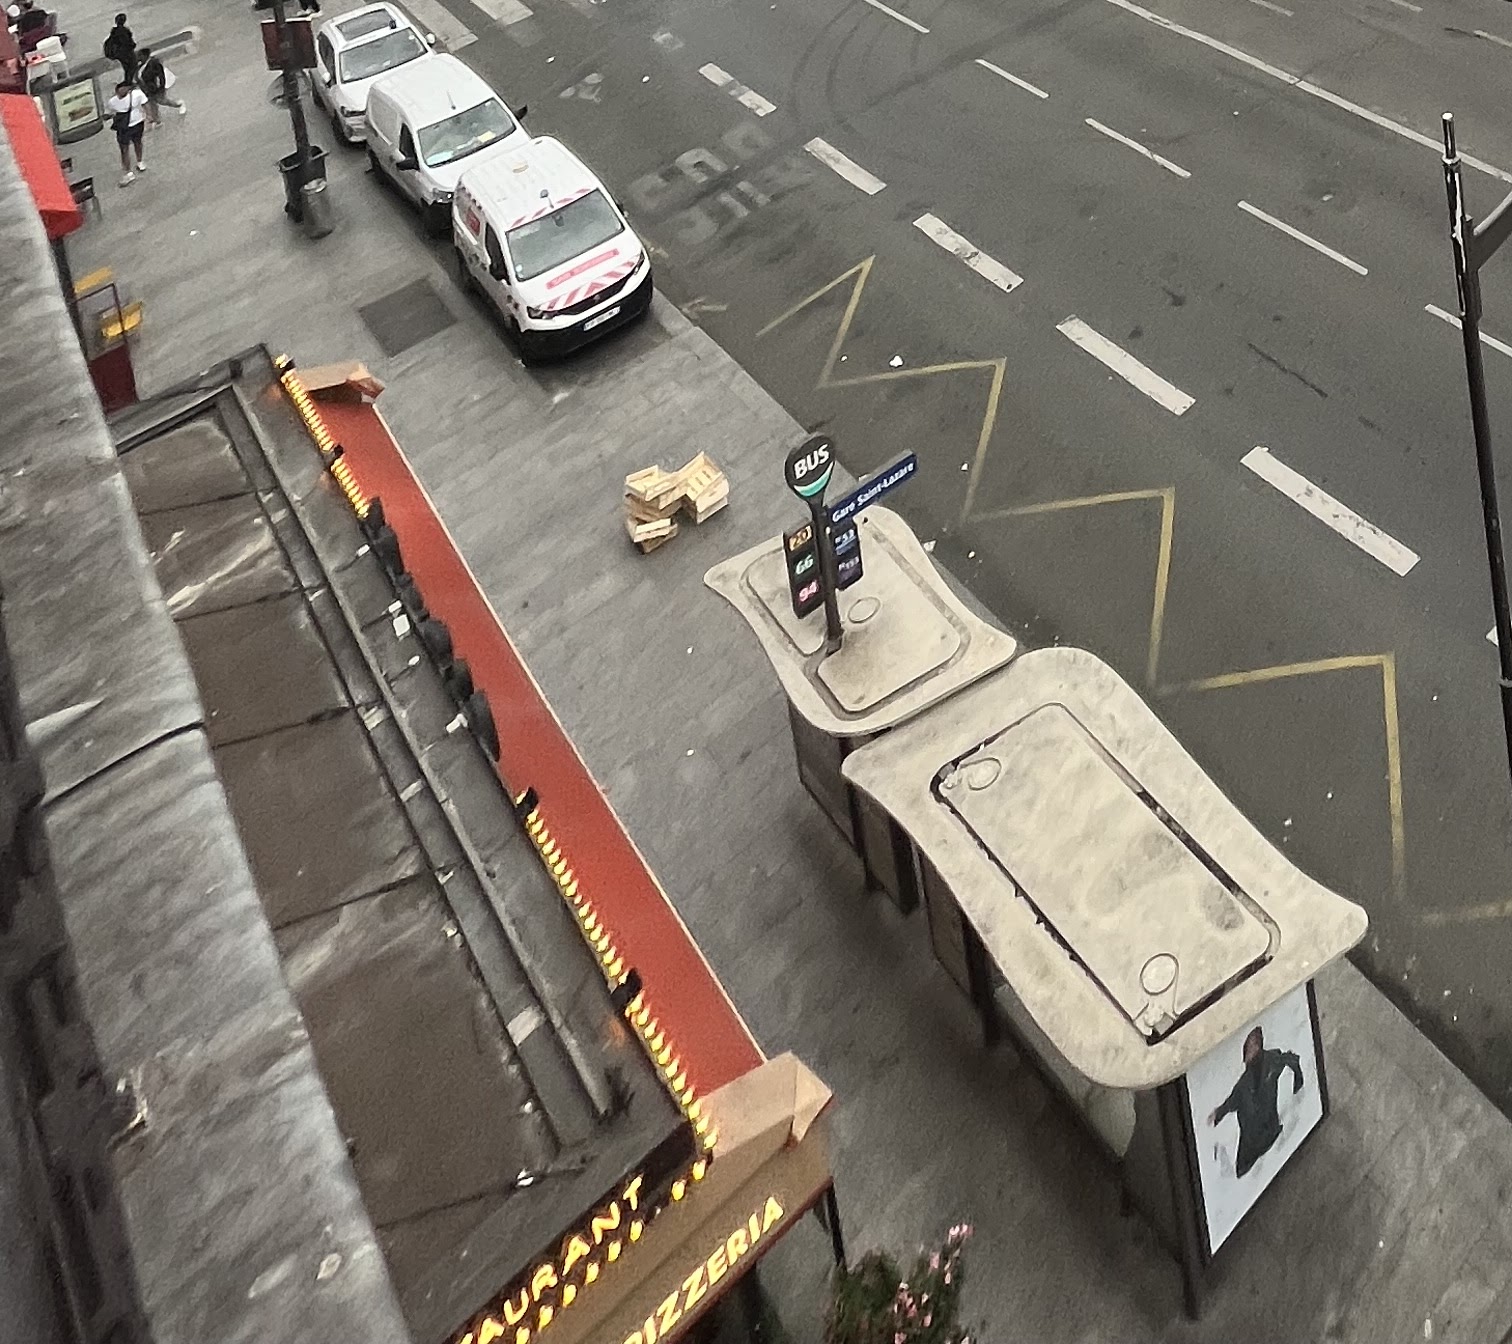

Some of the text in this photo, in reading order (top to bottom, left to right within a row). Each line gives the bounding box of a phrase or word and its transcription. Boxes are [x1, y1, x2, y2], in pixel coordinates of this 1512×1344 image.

[793, 443, 830, 480] BUS
[832, 462, 915, 523] Gare Saint-Lazare
[792, 528, 809, 548] 20
[795, 555, 814, 575] 66
[799, 580, 818, 602] 94
